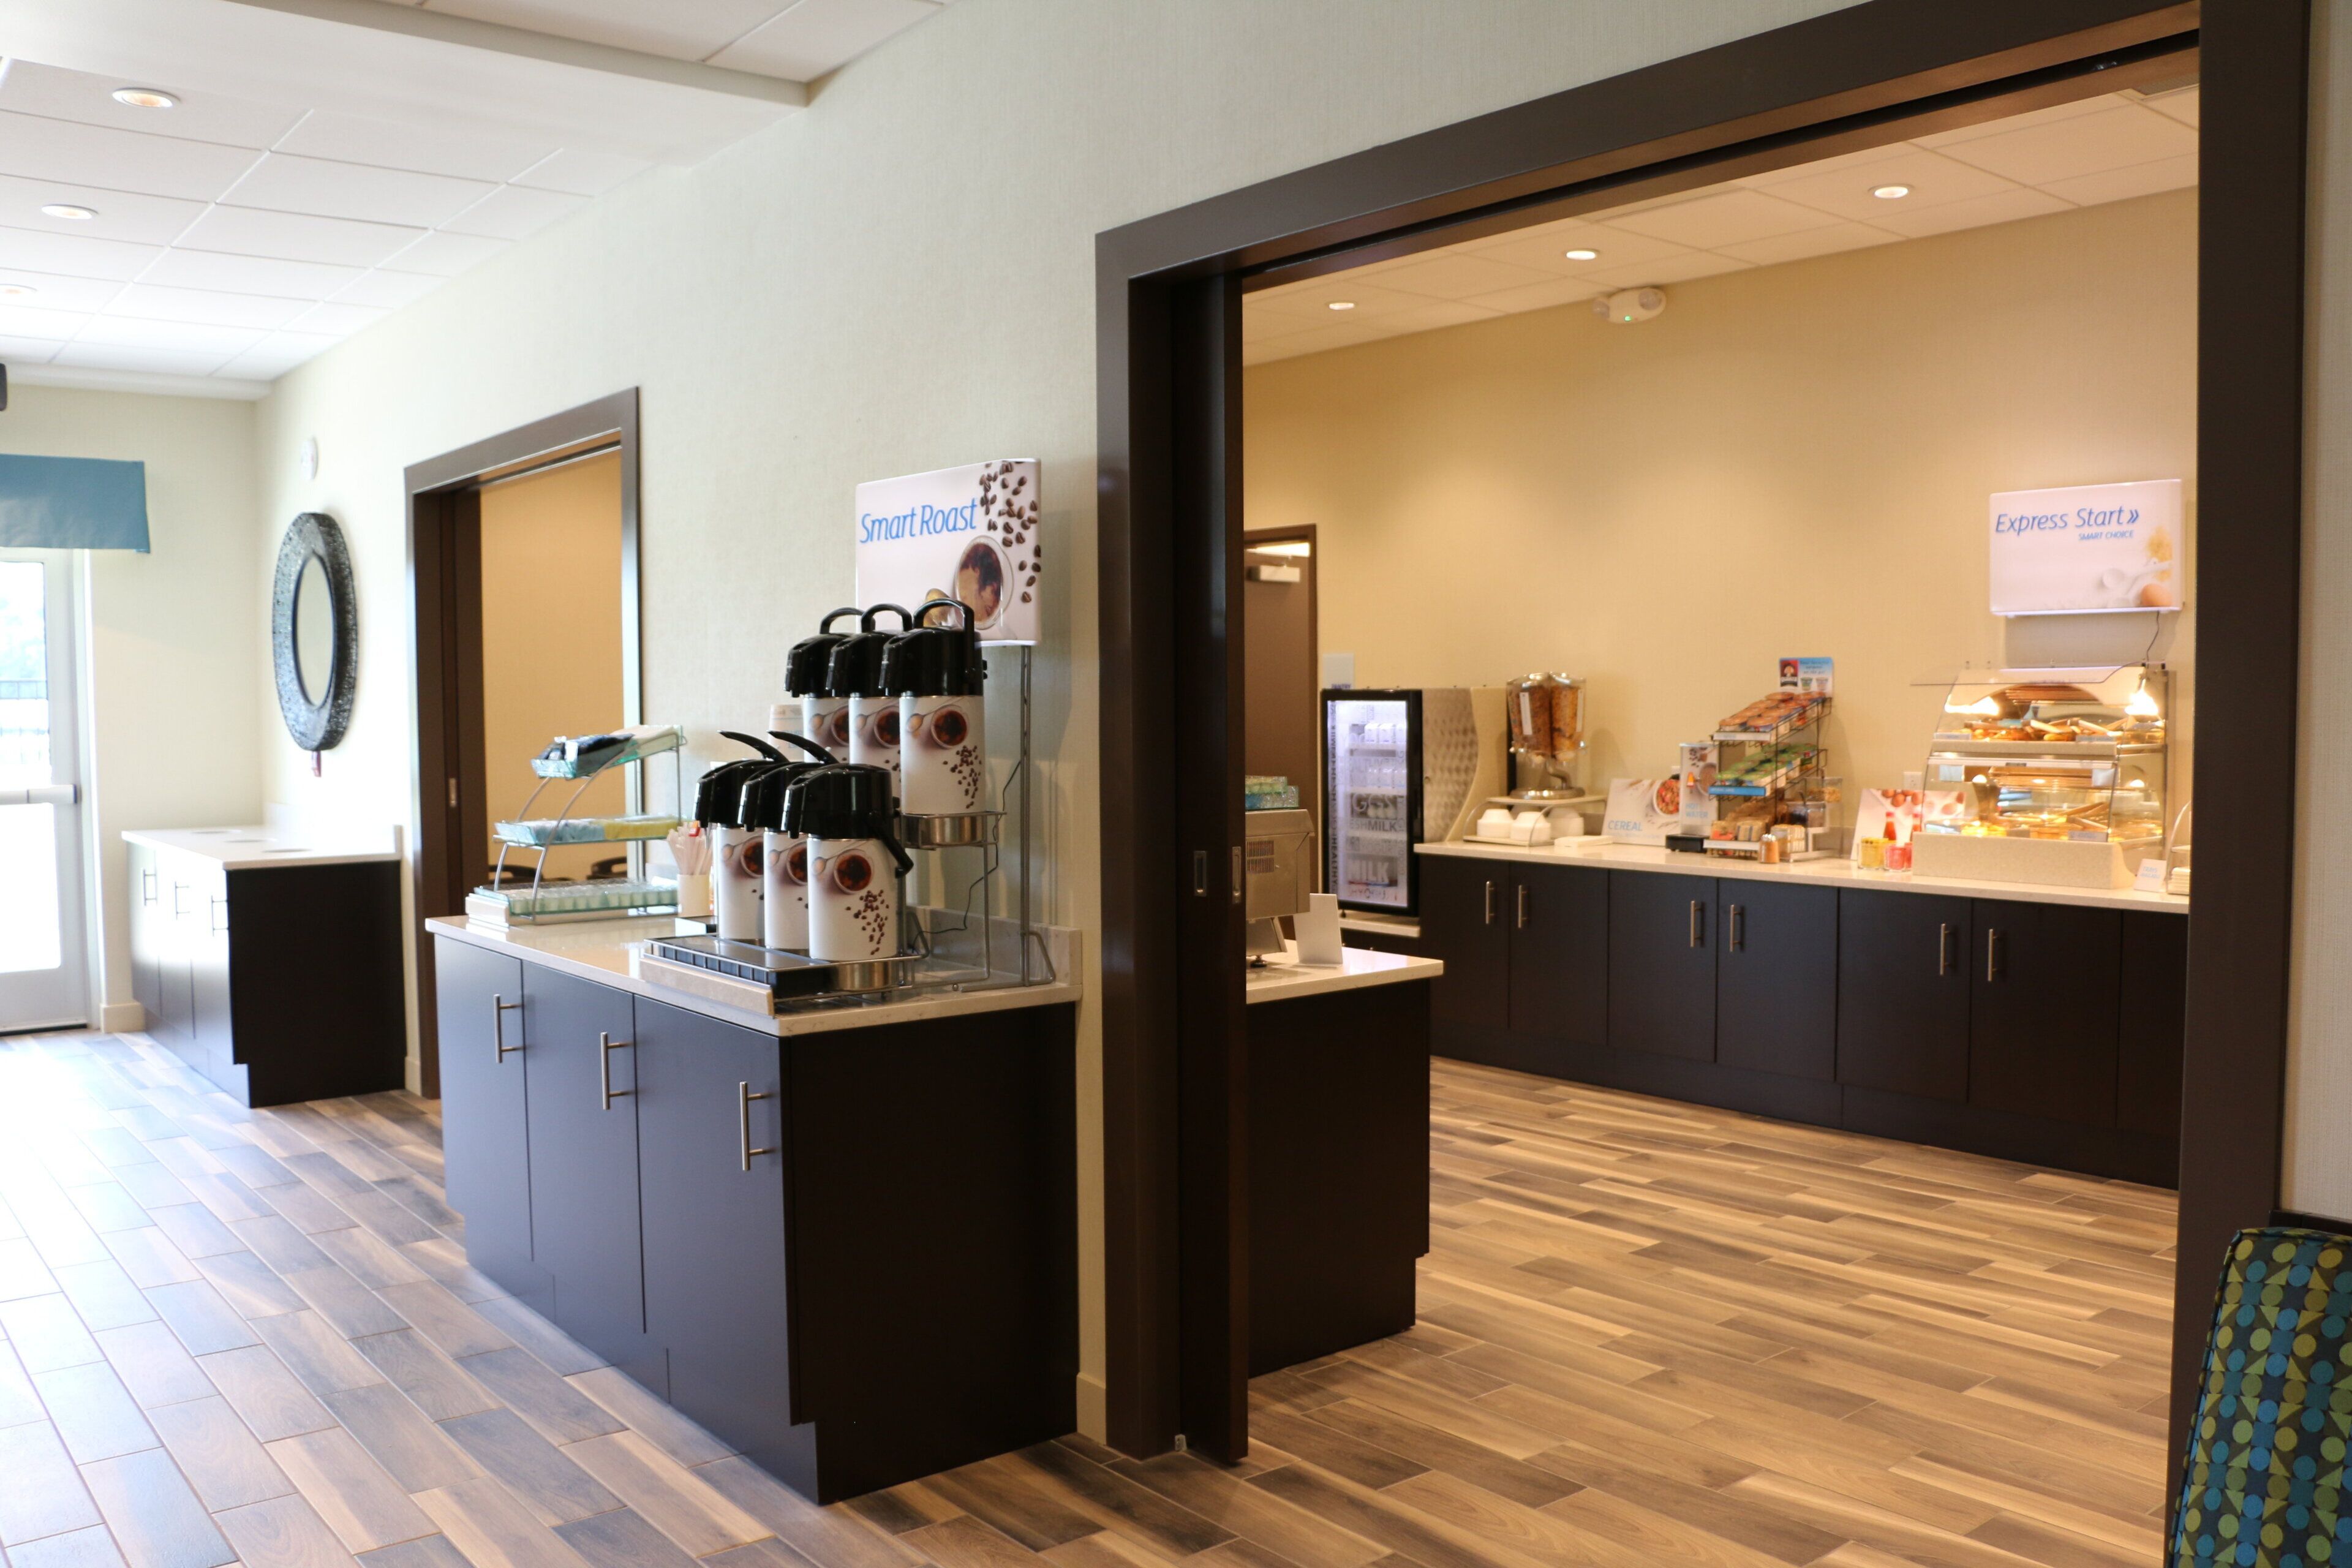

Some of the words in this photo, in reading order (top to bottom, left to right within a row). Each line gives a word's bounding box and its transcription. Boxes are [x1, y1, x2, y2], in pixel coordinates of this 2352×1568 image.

[859, 506, 917, 544] Smart
[919, 497, 978, 535] Roast
[1995, 512, 2068, 536] Express
[2078, 531, 2103, 541] SMART
[2105, 530, 2134, 540] CHOICE
[1608, 820, 1643, 832] CEREAL
